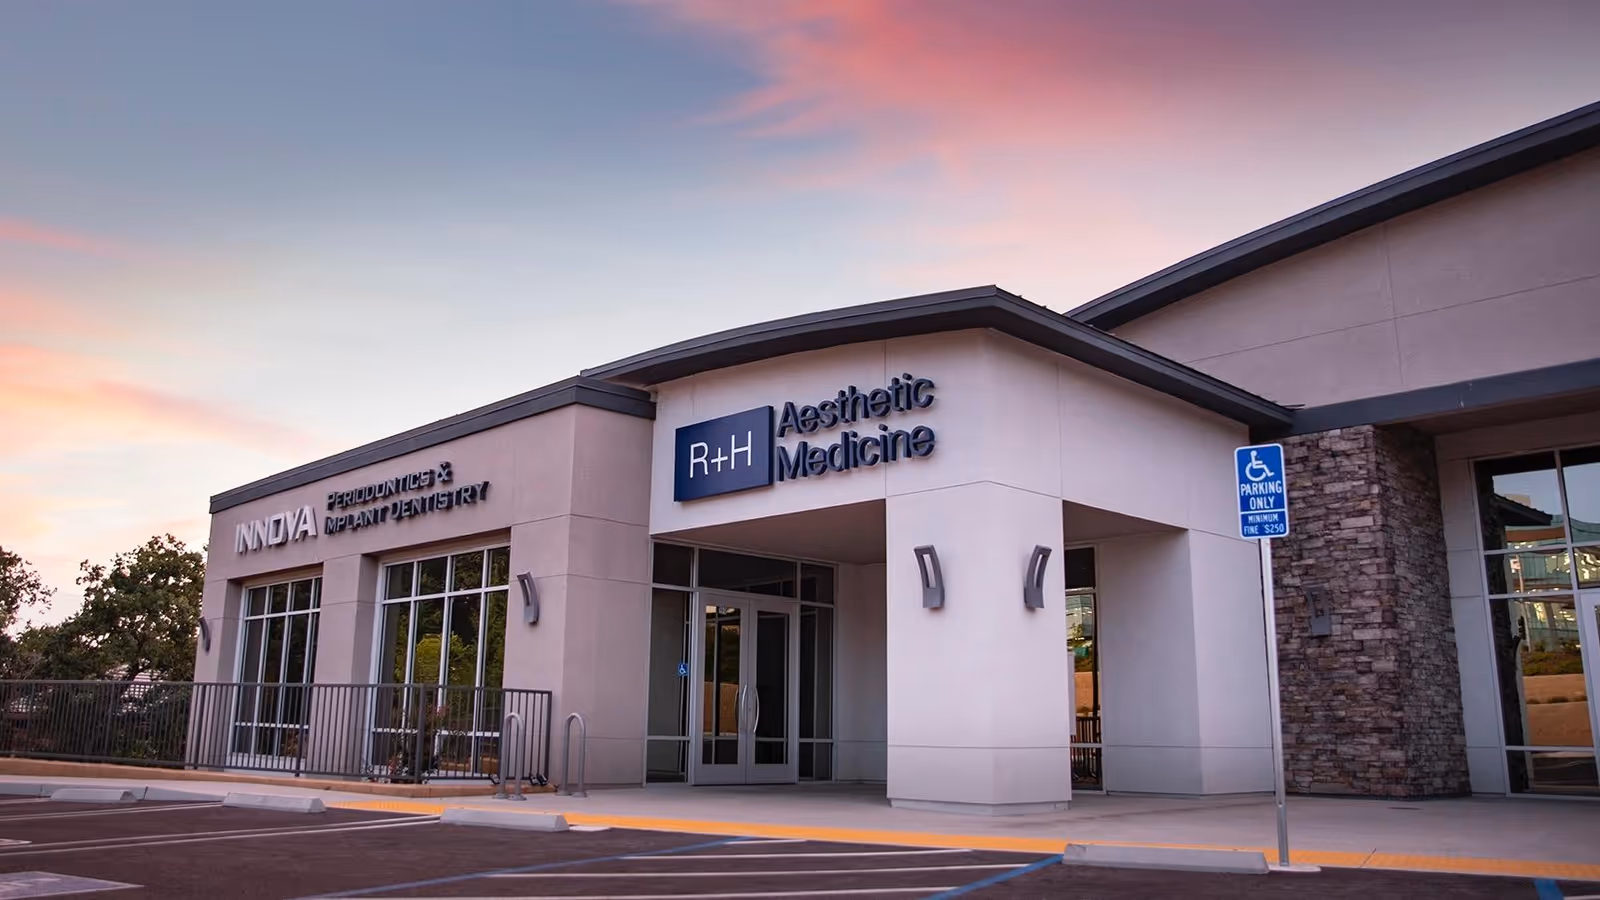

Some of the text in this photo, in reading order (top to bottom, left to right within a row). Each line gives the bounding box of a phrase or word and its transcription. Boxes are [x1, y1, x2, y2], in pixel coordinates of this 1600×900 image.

[777, 372, 935, 437] Aesthetic
[689, 430, 752, 479] R+H
[777, 424, 936, 482] Medicine
[326, 461, 453, 511] PERIODONTICS &
[388, 481, 491, 520] DENTISTRY
[1240, 481, 1282, 496] PARKING
[1249, 496, 1275, 510] ONLY
[234, 505, 317, 553] INNOVA
[1243, 523, 1285, 535] FINE $250
[1248, 513, 1279, 524] MINIMUM
